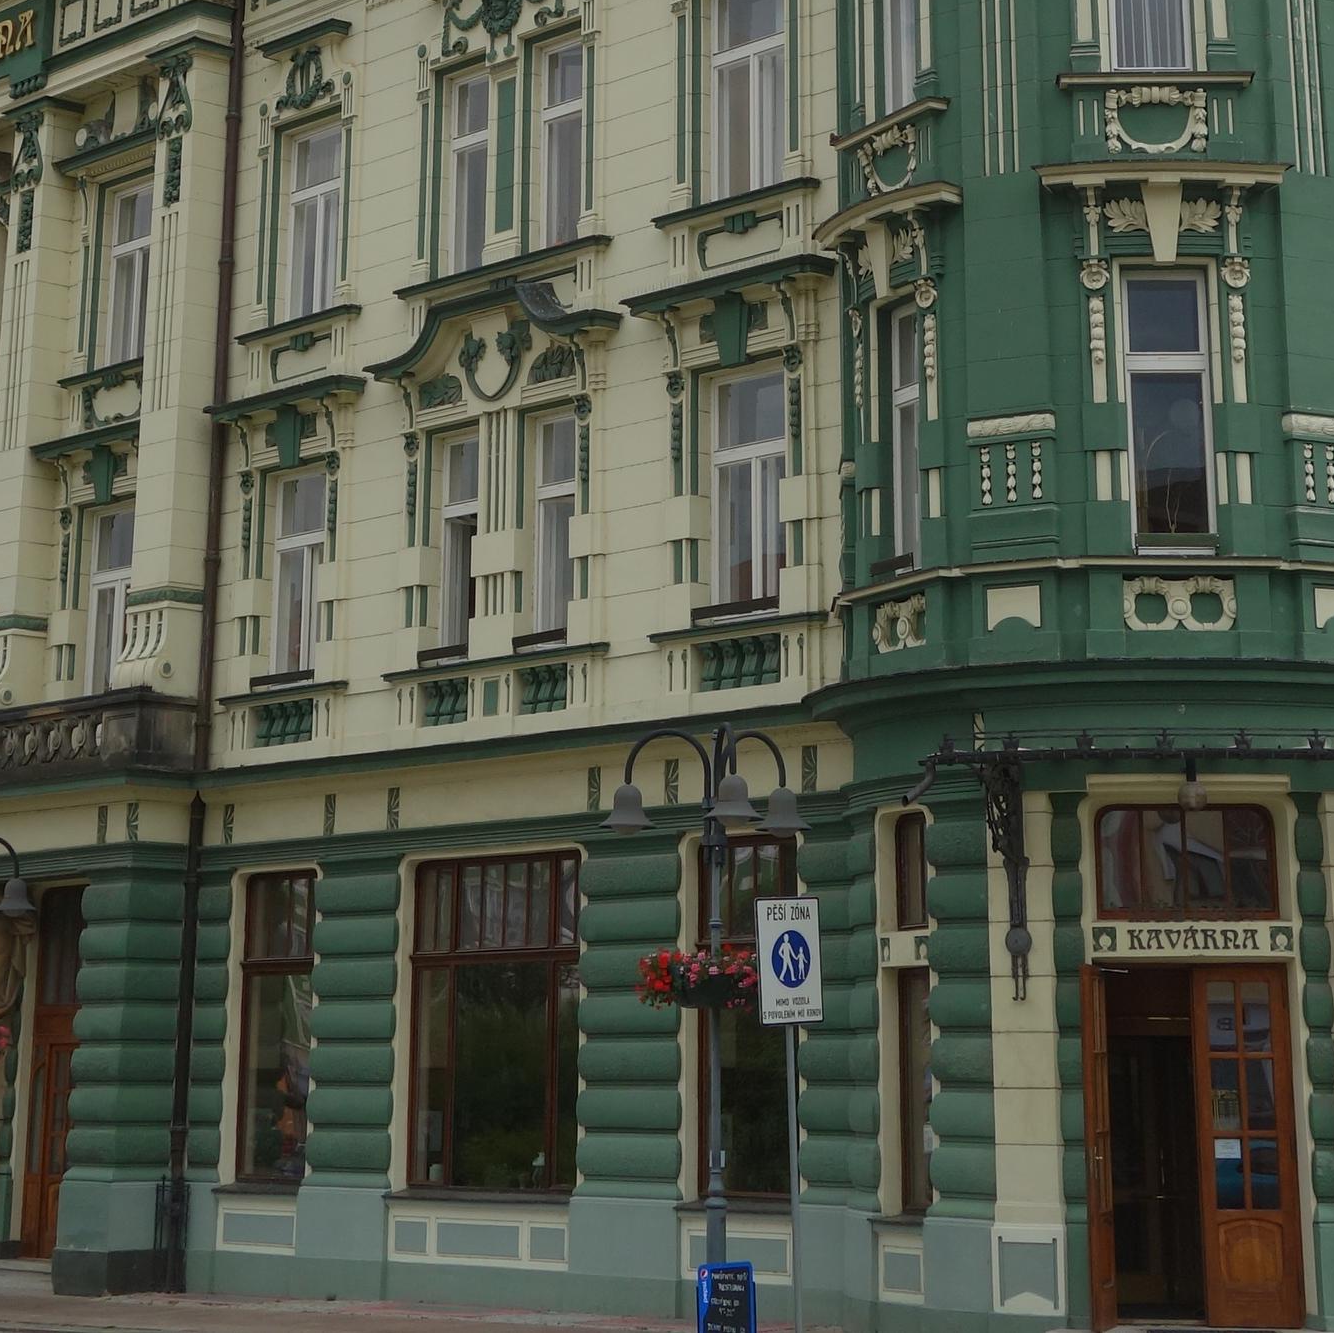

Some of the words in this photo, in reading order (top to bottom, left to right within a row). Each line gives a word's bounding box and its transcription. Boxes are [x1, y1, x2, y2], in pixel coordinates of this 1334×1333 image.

[766, 903, 786, 921] PĚŠÍ
[790, 903, 811, 921] ZÓNA
[1127, 926, 1260, 951] KAVÁRNA
